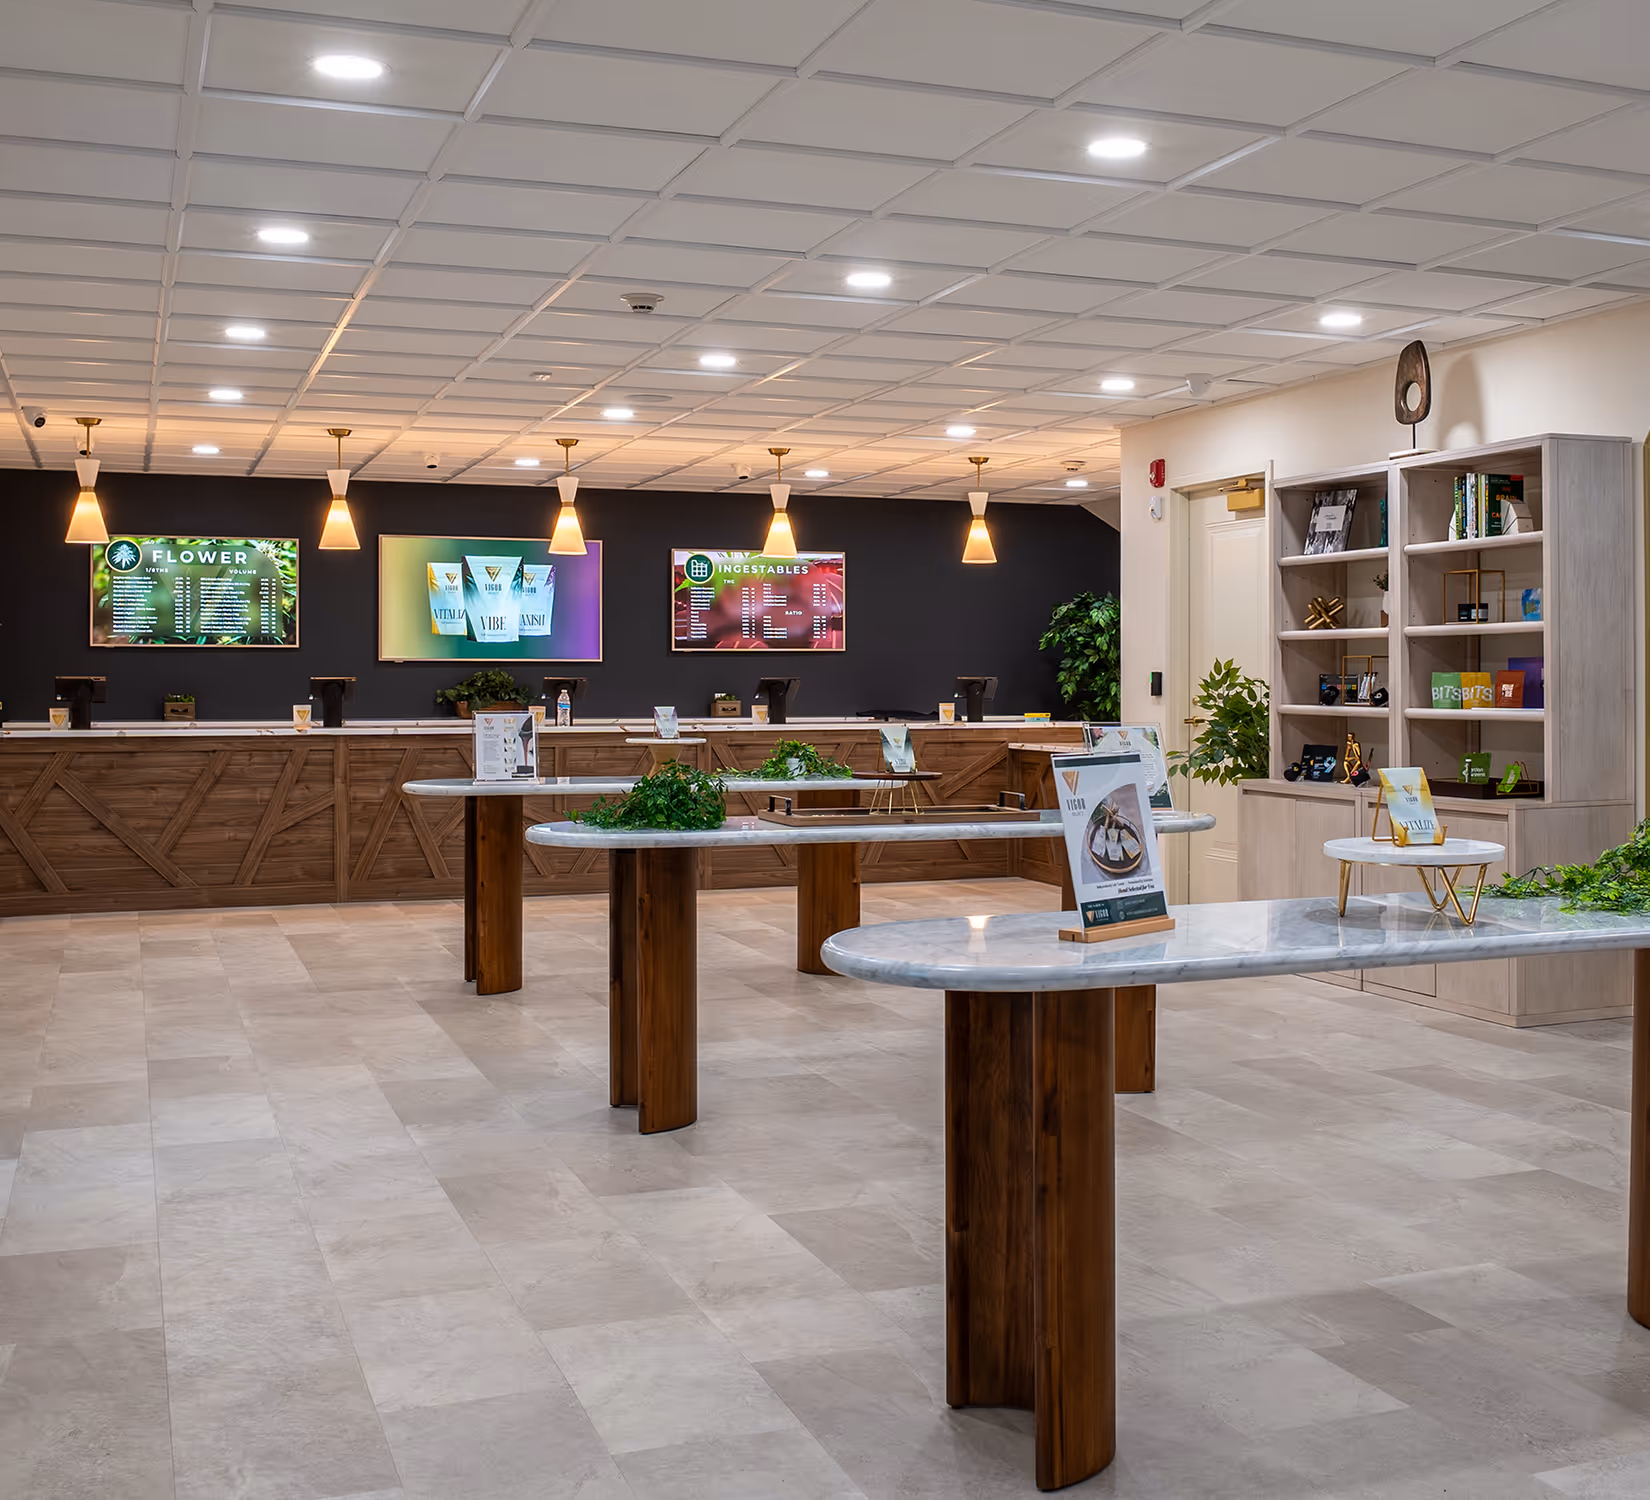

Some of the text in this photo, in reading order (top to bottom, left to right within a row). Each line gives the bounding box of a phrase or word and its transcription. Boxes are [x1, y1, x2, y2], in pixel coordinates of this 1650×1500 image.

[152, 550, 248, 565] FLOWER
[718, 564, 809, 575] INGESTABLES
[484, 583, 503, 592] VIGOR
[434, 608, 466, 620] VITALIZ
[519, 614, 545, 627] ANISH
[480, 616, 507, 631] VIBE
[1431, 685, 1461, 701] BITS
[1461, 685, 1493, 701] BITS
[1066, 798, 1087, 811] VIGOR
[1095, 908, 1109, 918] VIGOR
